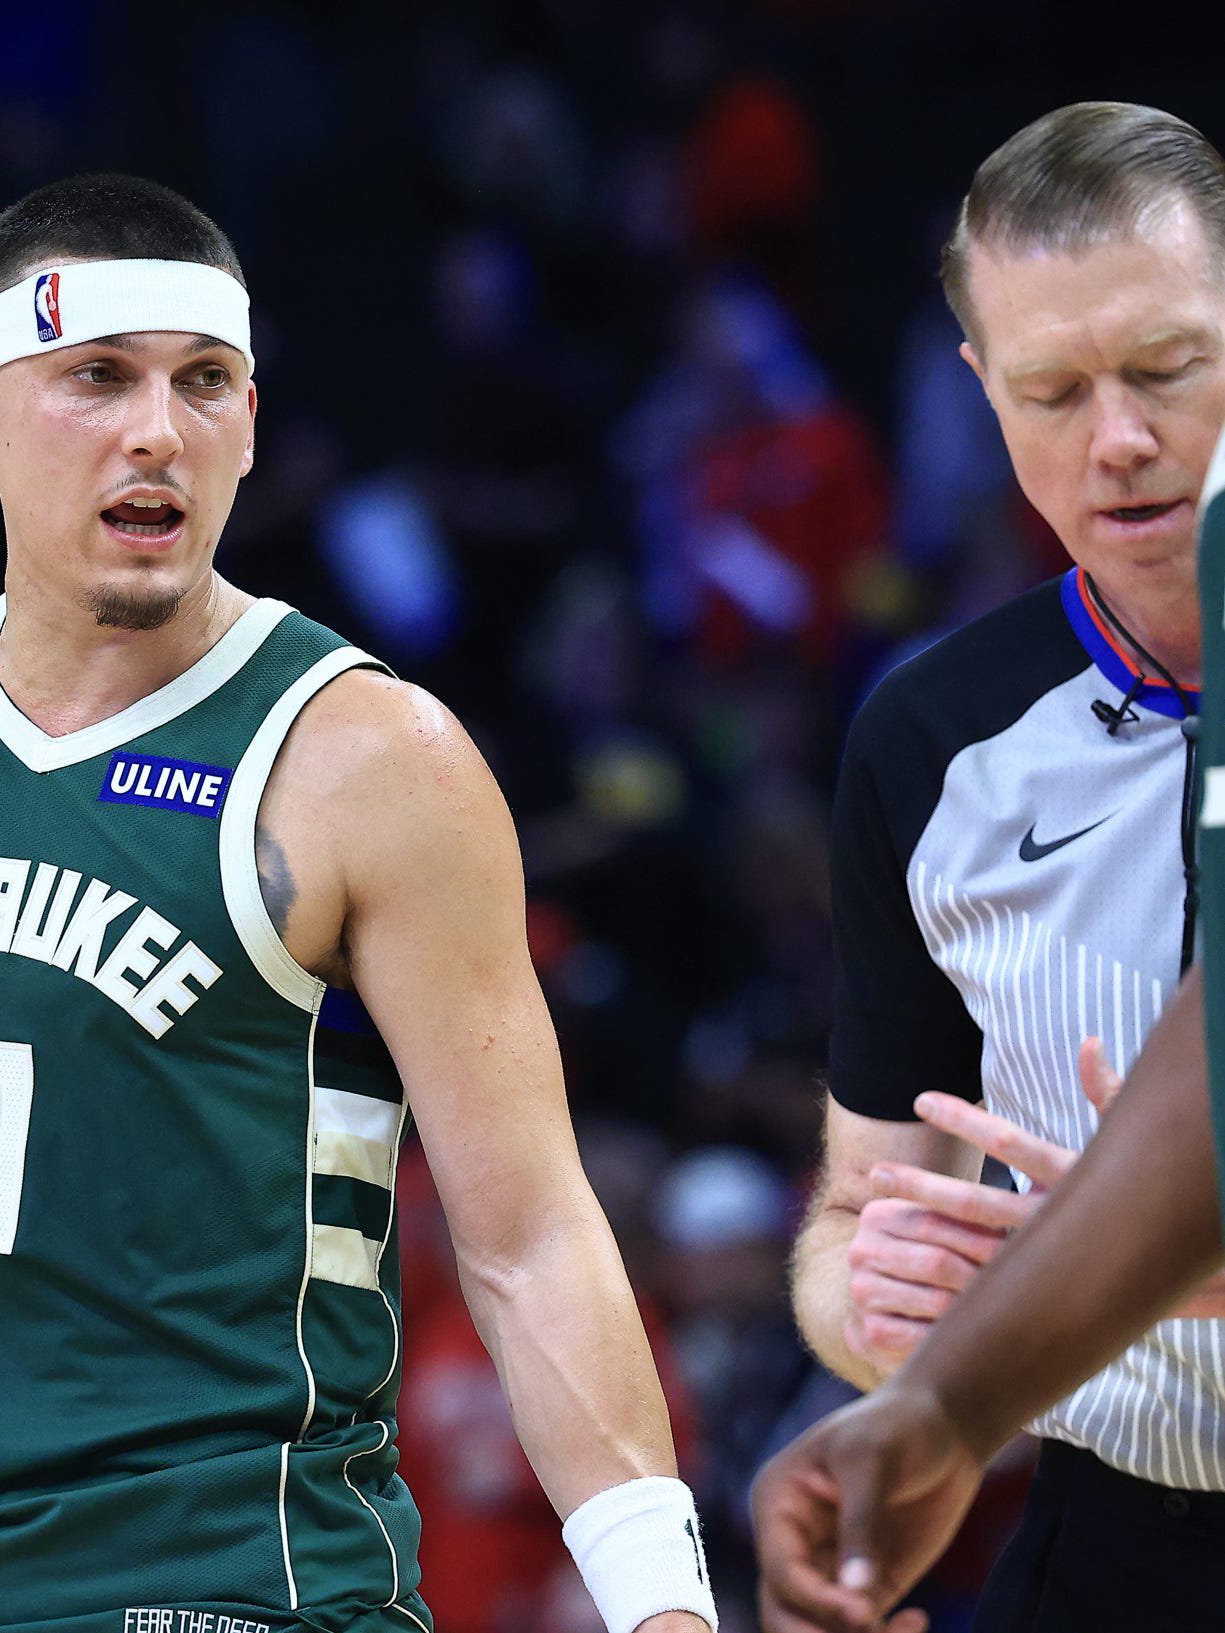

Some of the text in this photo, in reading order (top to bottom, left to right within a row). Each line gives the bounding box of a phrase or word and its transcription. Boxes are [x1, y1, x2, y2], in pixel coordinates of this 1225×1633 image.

[111, 761, 223, 807] ULINE
[124, 1608, 173, 1633] FEAR
[177, 1610, 215, 1633] THE
